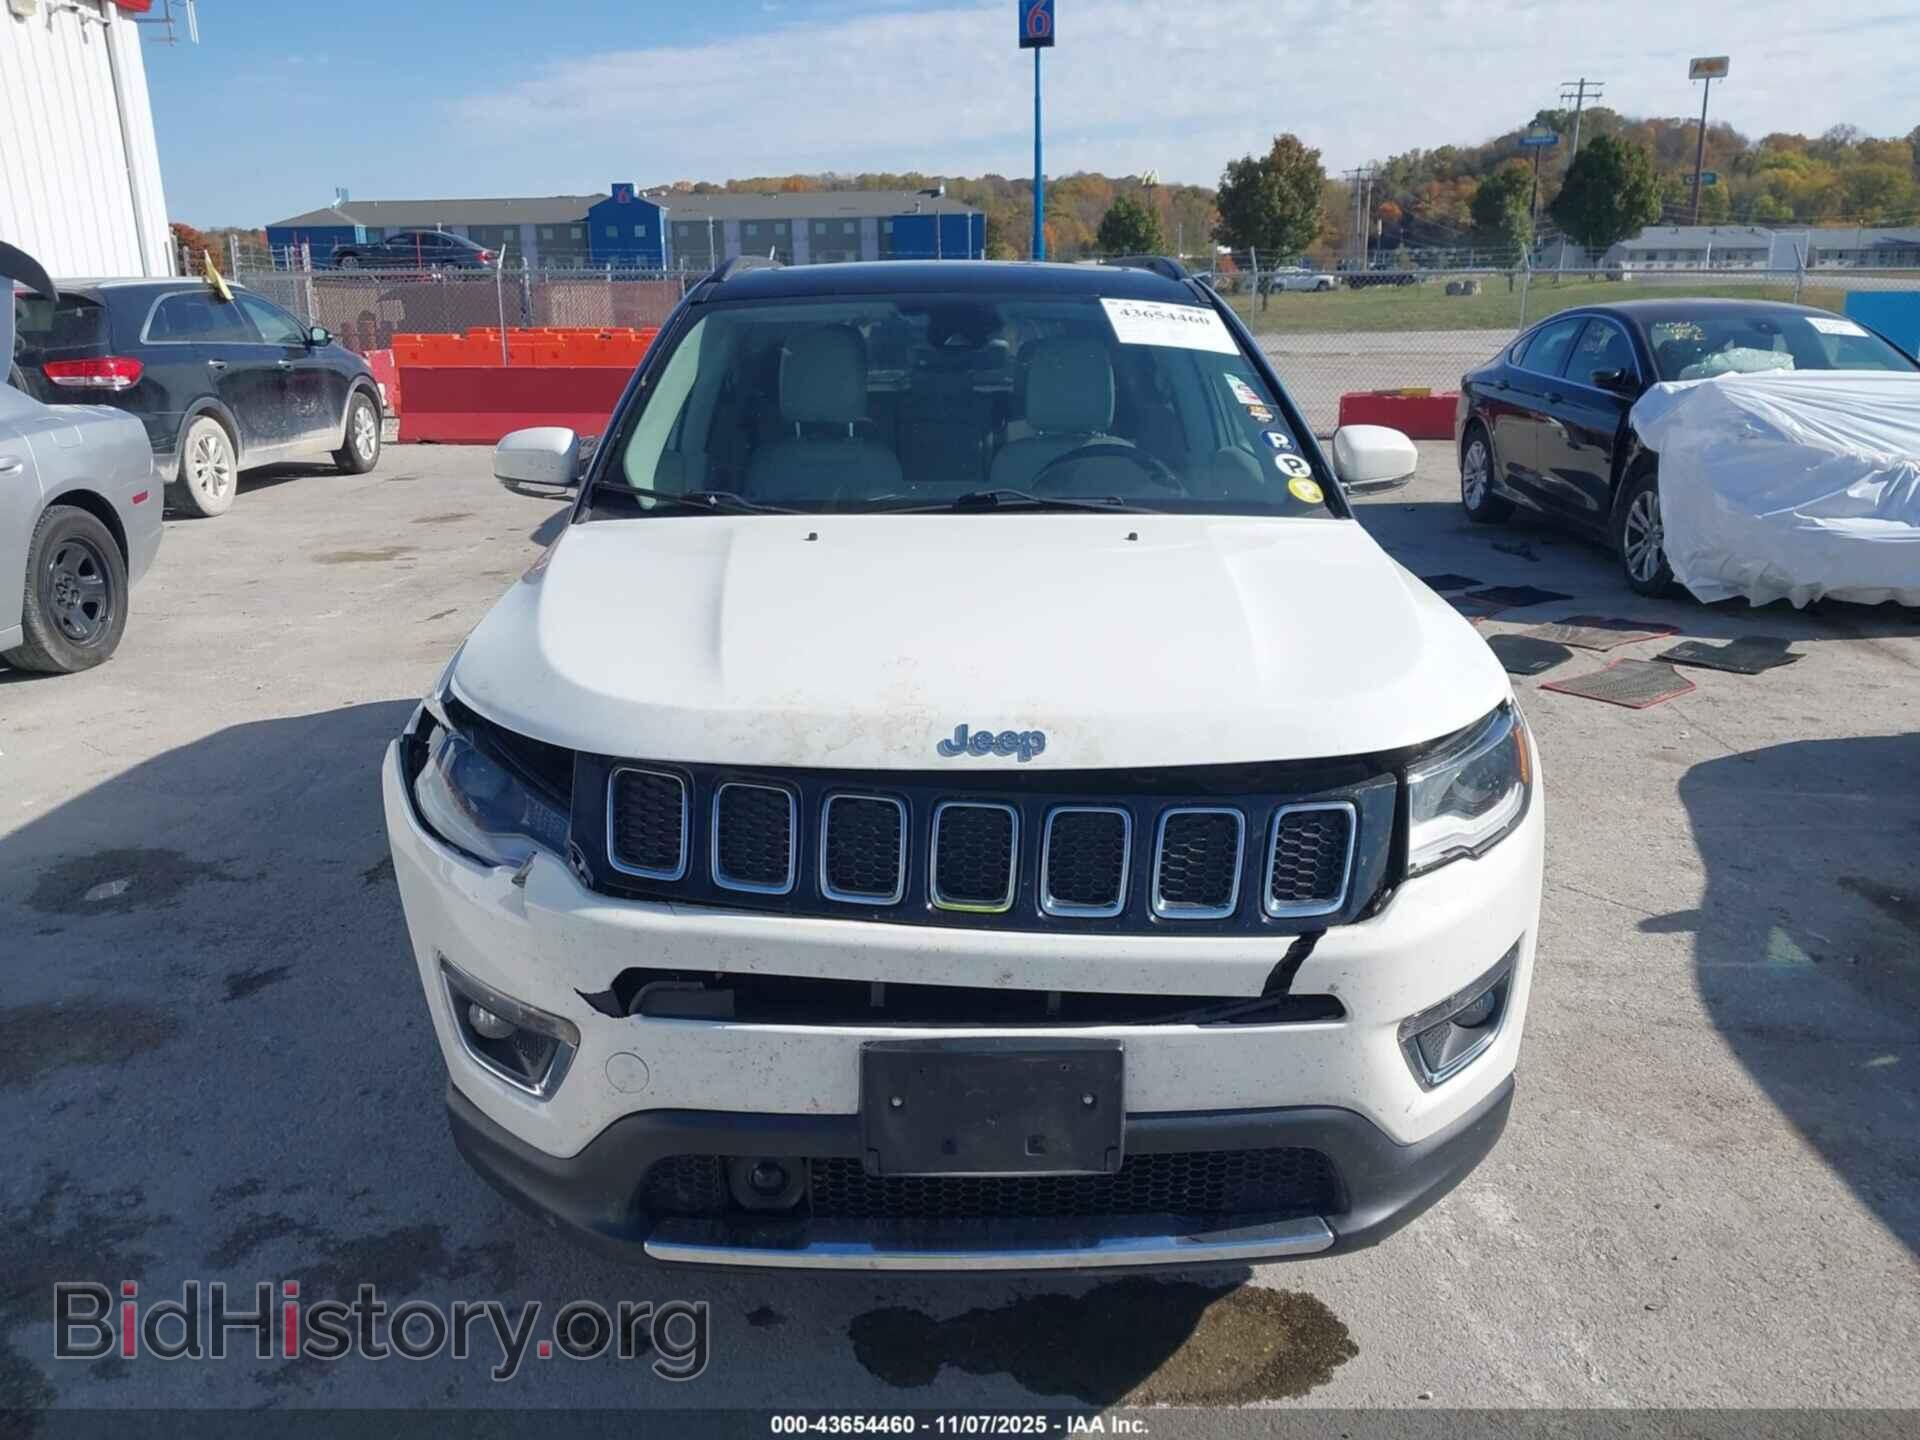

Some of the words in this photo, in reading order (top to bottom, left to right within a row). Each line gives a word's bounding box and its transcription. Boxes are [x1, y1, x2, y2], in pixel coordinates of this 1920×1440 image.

[1027, 0, 1051, 38] 6
[1267, 432, 1289, 448] P
[1281, 458, 1303, 474] P
[936, 723, 1046, 763] Jeep
